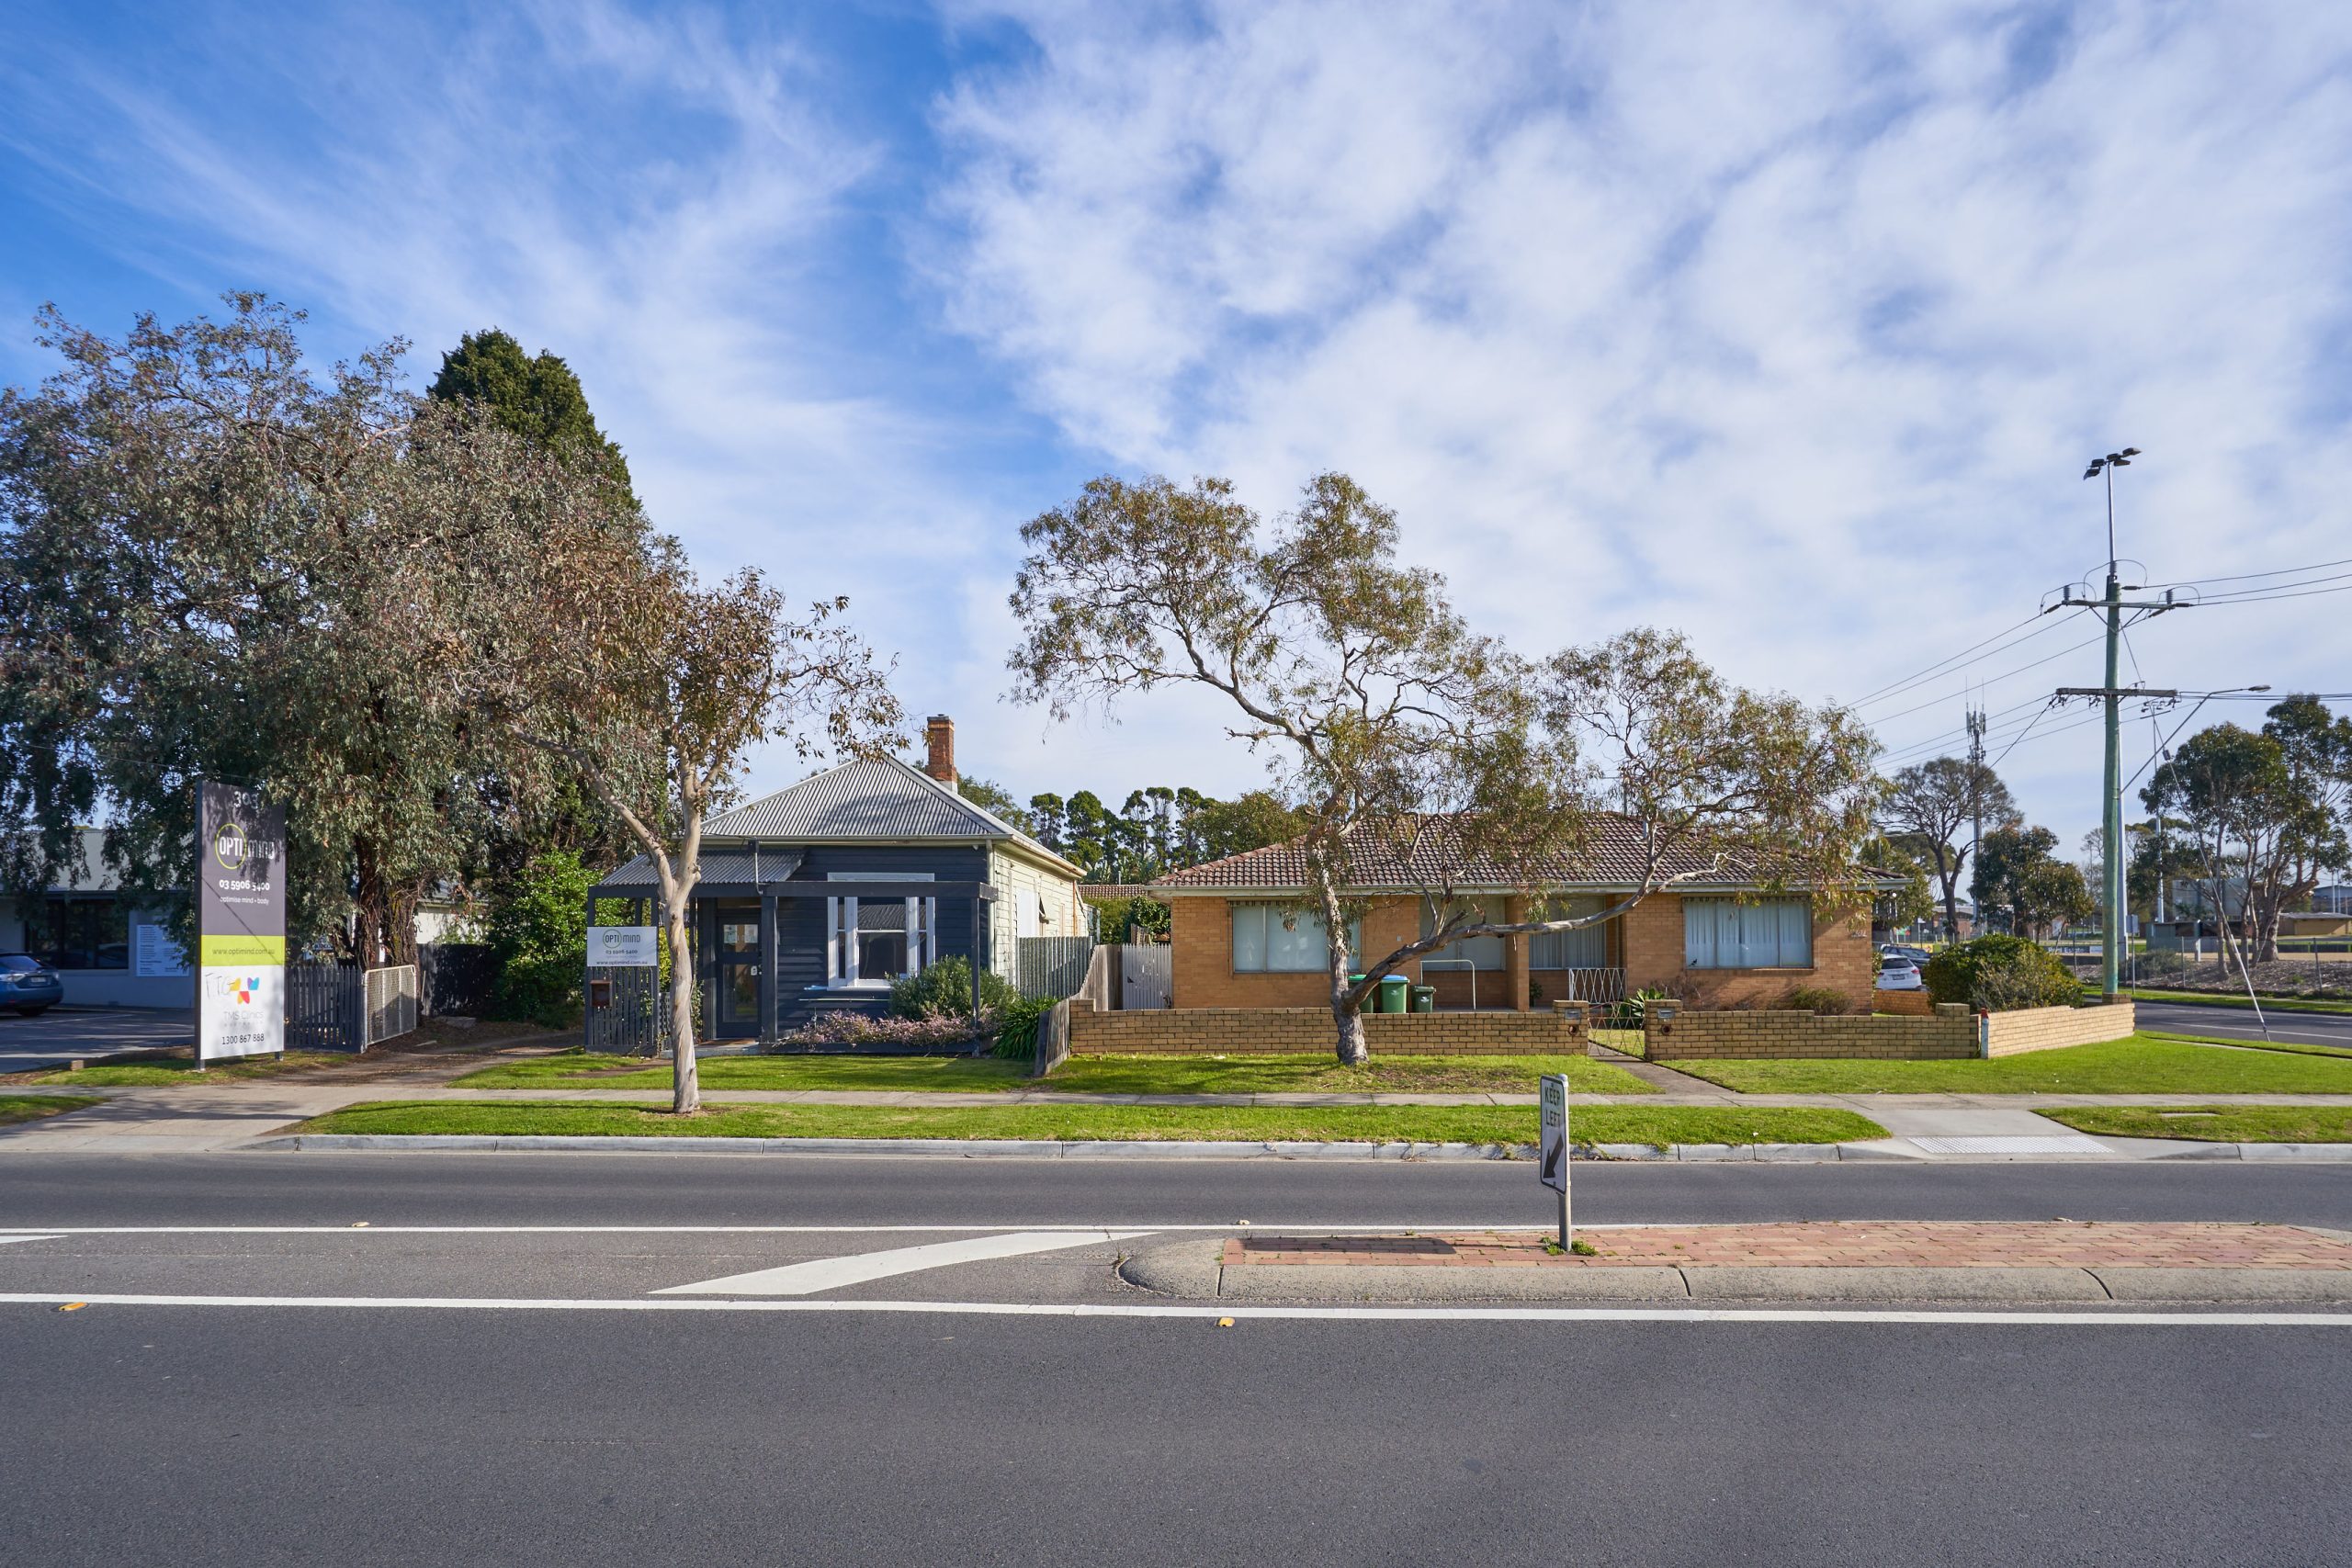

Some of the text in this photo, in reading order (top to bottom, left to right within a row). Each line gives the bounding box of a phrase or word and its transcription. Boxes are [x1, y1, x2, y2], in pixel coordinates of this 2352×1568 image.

[220, 836, 243, 856] OPTI
[220, 879, 270, 892] 03 5906 5400
[221, 1033, 265, 1045] 1300 867 888
[1544, 1087, 1560, 1106] KEEP
[1546, 1110, 1560, 1127] LEFT
